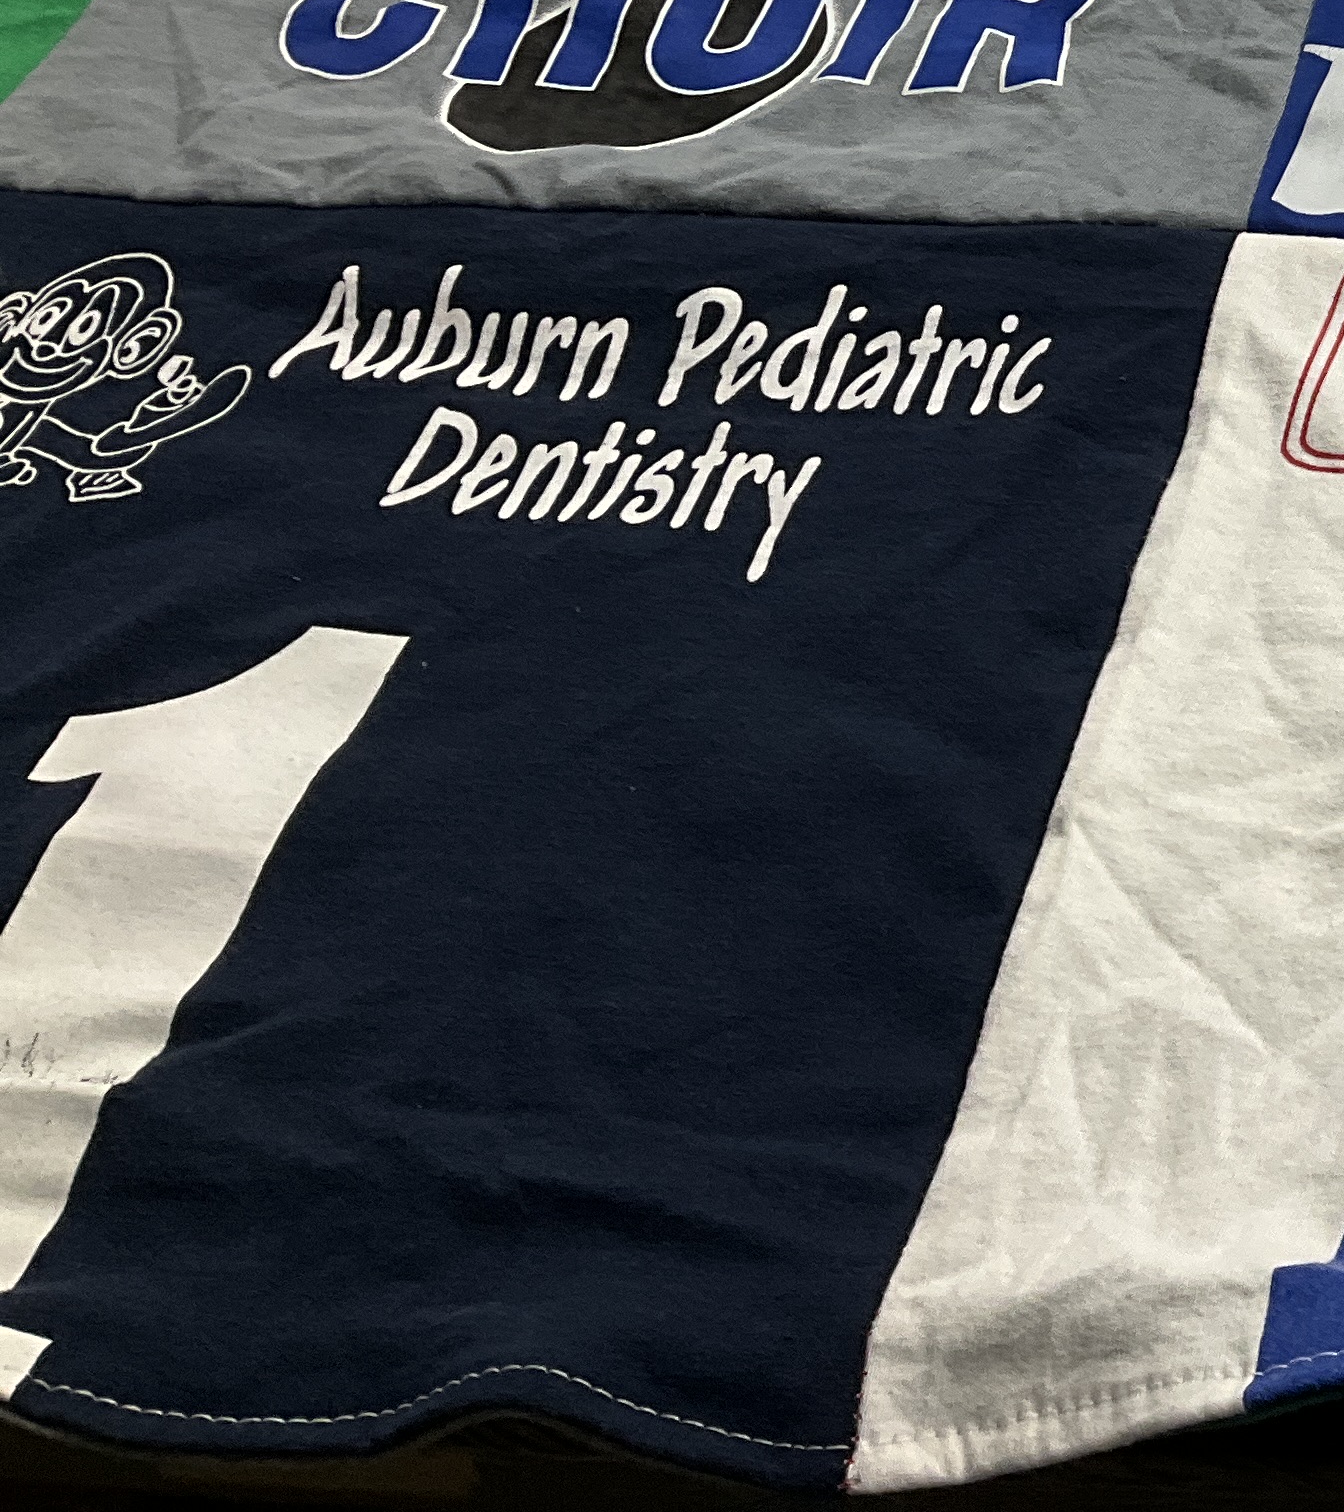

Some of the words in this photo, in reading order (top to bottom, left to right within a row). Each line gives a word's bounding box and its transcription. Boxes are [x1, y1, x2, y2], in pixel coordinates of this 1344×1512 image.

[267, 263, 632, 403] Auburn
[657, 283, 1053, 419] Pediatric
[379, 406, 822, 584] Dentistry
[0, 625, 411, 1403] 1
